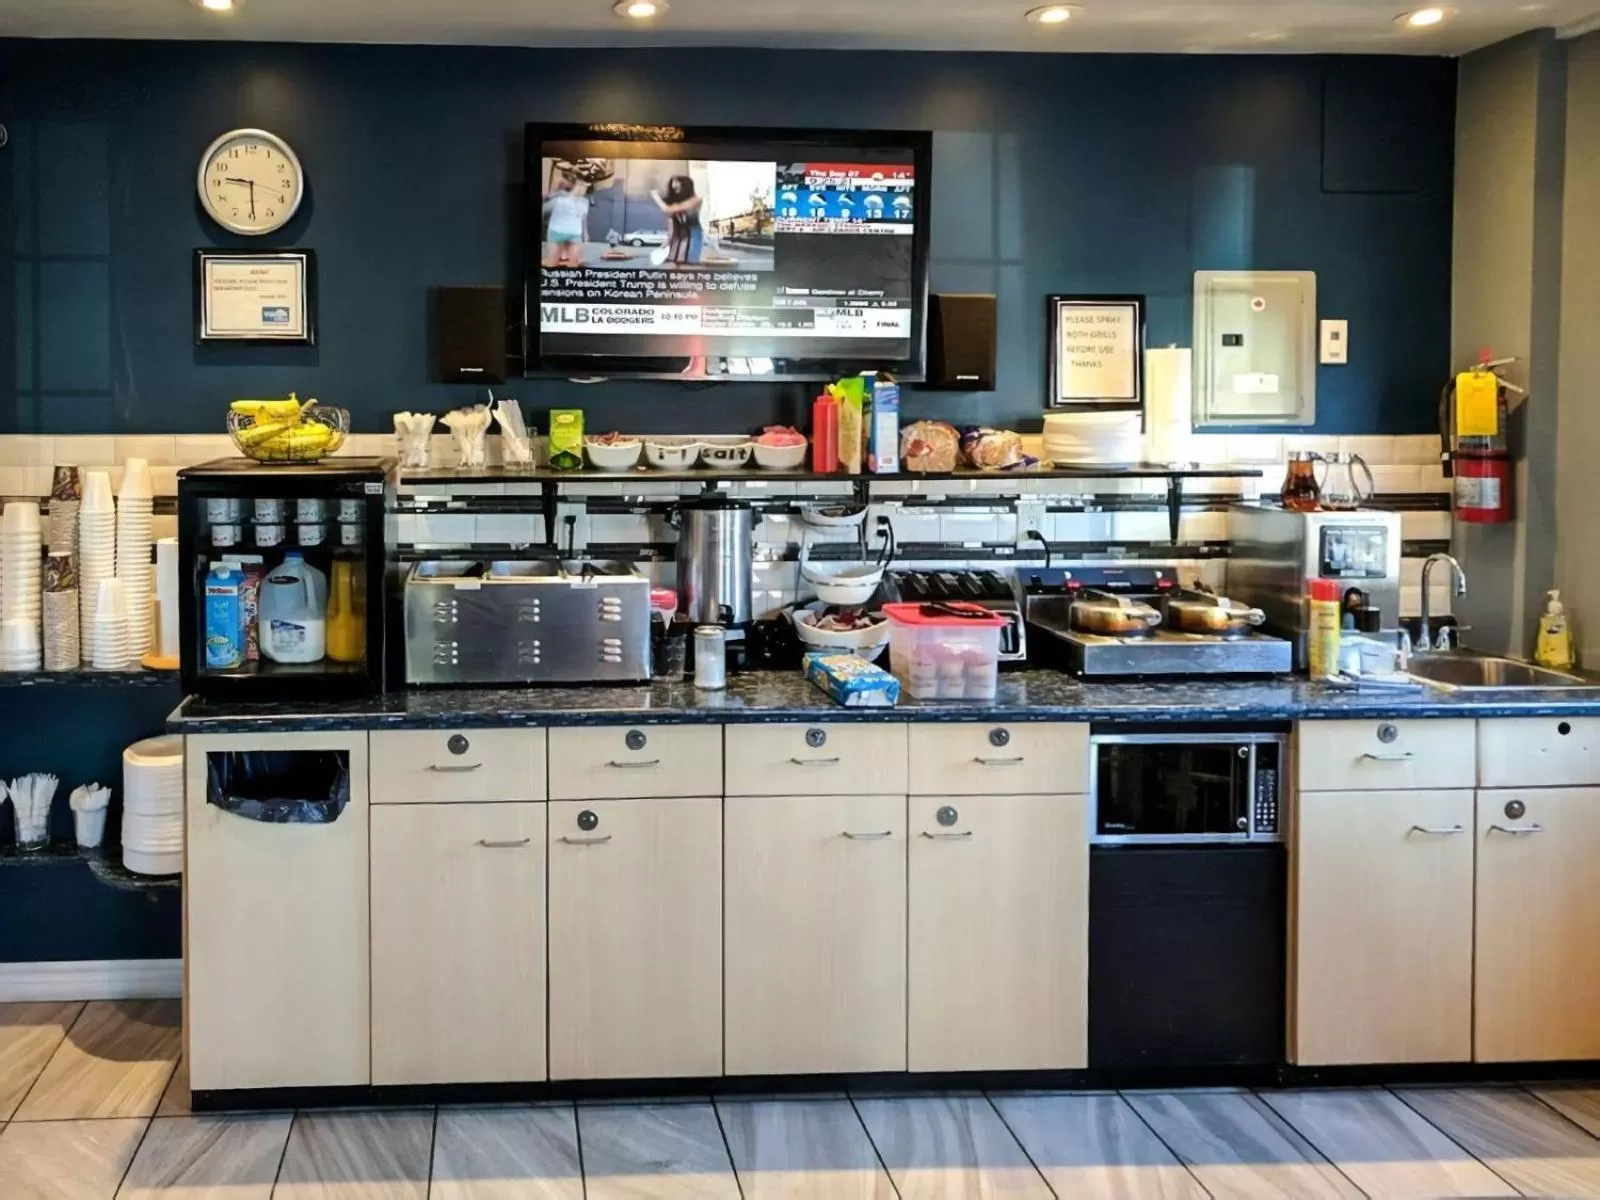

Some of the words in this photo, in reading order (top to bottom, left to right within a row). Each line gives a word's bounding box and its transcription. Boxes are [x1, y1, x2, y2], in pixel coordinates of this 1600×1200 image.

[244, 144, 258, 155] 12
[216, 162, 228, 172] 10
[276, 163, 285, 173] 2
[212, 178, 221, 188] 9
[281, 178, 291, 188] 3
[277, 194, 285, 204] 4
[584, 269, 636, 279] President
[638, 270, 667, 280] Putin
[669, 272, 695, 282] says
[697, 272, 711, 281] he
[565, 279, 617, 288] President
[619, 279, 655, 289] Trump
[669, 281, 703, 291] willing
[705, 282, 717, 290] to
[540, 288, 584, 297] ensions
[586, 289, 601, 297] on
[604, 289, 643, 298] Korean
[540, 307, 590, 323] MLB
[591, 308, 655, 316] COLORADO
[606, 316, 655, 324] DODGERS
[1065, 315, 1094, 324] PLEASE
[1096, 315, 1121, 324] SPRAY
[1066, 330, 1089, 338] BOTH
[1090, 330, 1117, 339] GRILLS
[1066, 345, 1096, 353] BEFORE
[1098, 345, 1115, 353] USE
[1071, 360, 1103, 368] THANKS
